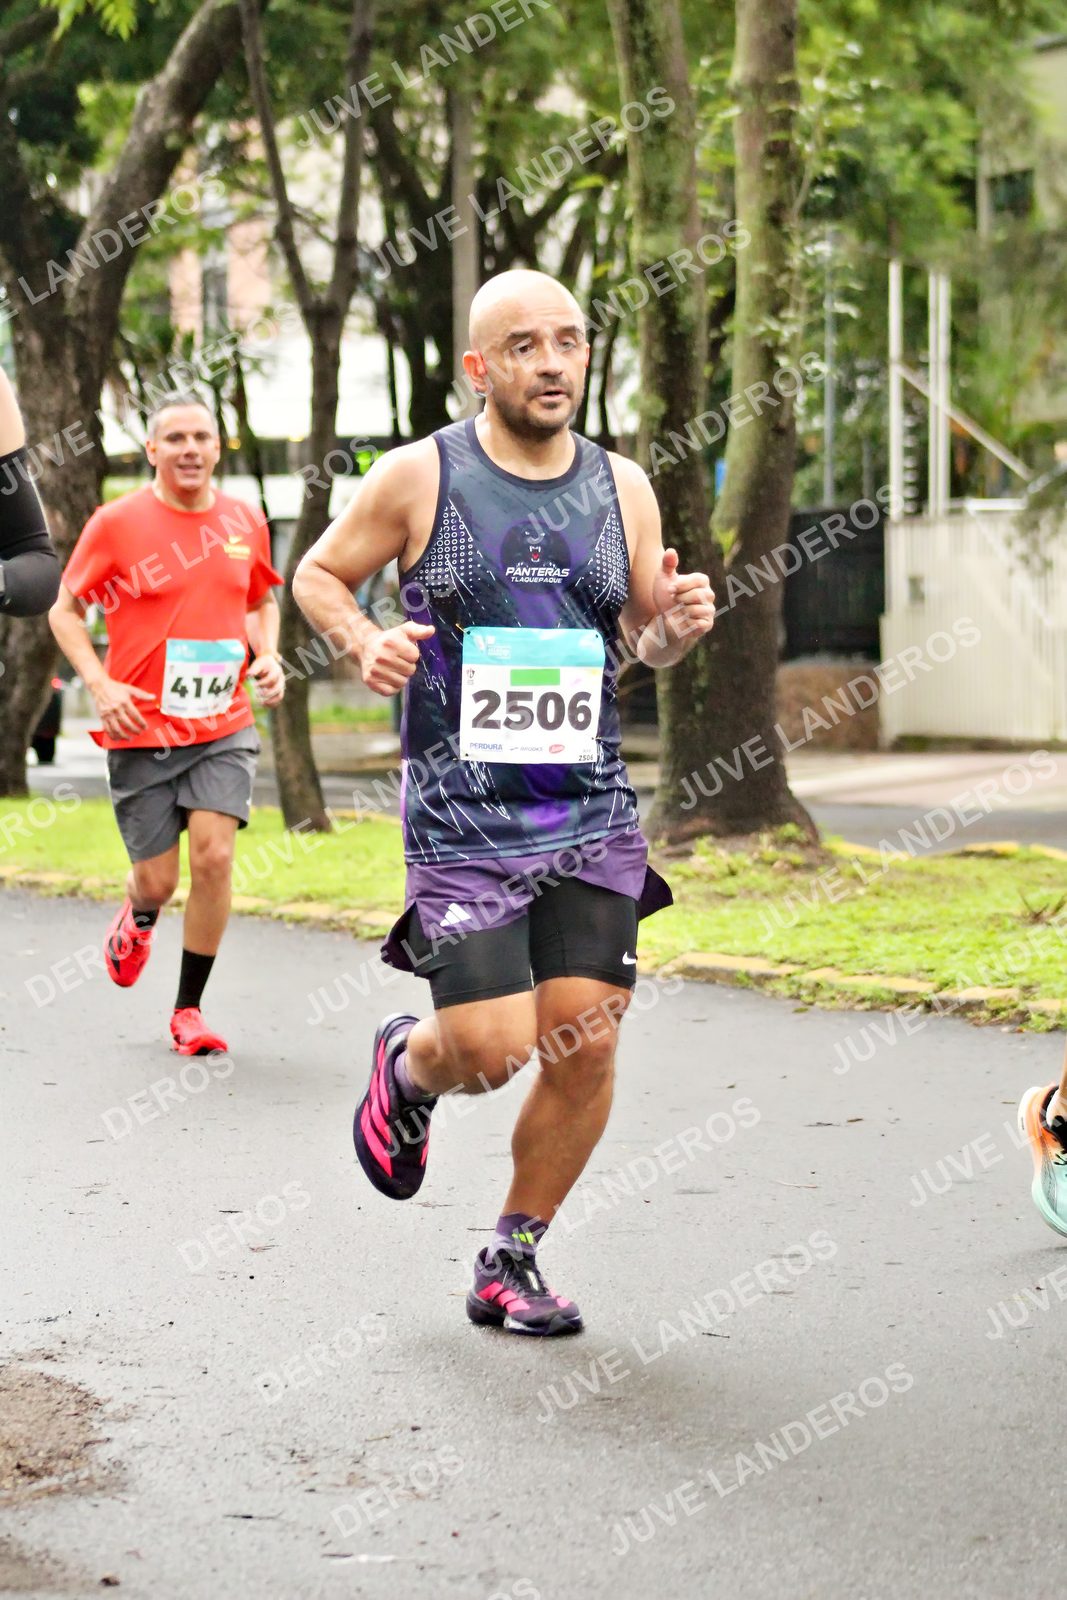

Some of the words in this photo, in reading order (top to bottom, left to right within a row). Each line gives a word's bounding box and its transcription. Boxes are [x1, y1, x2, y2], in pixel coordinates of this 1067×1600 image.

[505, 567, 570, 577] PANTERAS
[511, 576, 563, 584] TLAQUEPAQUE
[471, 689, 592, 731] 2506
[469, 742, 503, 751] PERDURA
